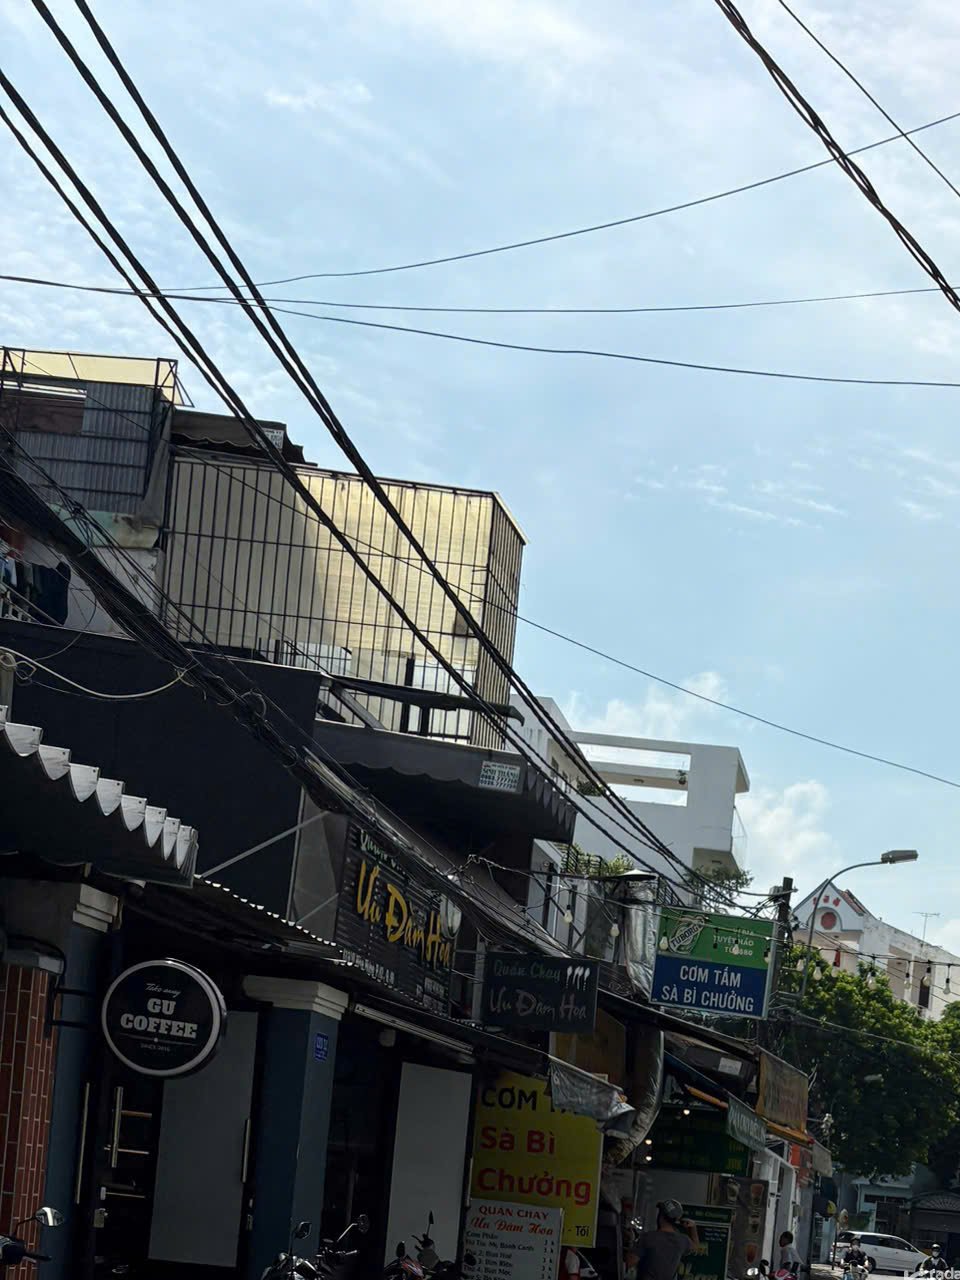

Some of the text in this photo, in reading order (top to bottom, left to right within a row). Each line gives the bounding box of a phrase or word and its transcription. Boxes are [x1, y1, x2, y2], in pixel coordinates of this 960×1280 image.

[671, 924, 699, 948] TUBORG
[680, 965, 741, 988] CƠM TẤM
[147, 997, 176, 1015] GU
[559, 992, 587, 1023] Hoa
[661, 984, 754, 1012] SÀ BÌ CHƯỞNG
[120, 1013, 198, 1039] COFFEE
[481, 1086, 538, 1111] CƠM
[480, 1126, 555, 1155] Sà Bì
[478, 1168, 592, 1207] Chưởng
[576, 1225, 590, 1237] Tối
